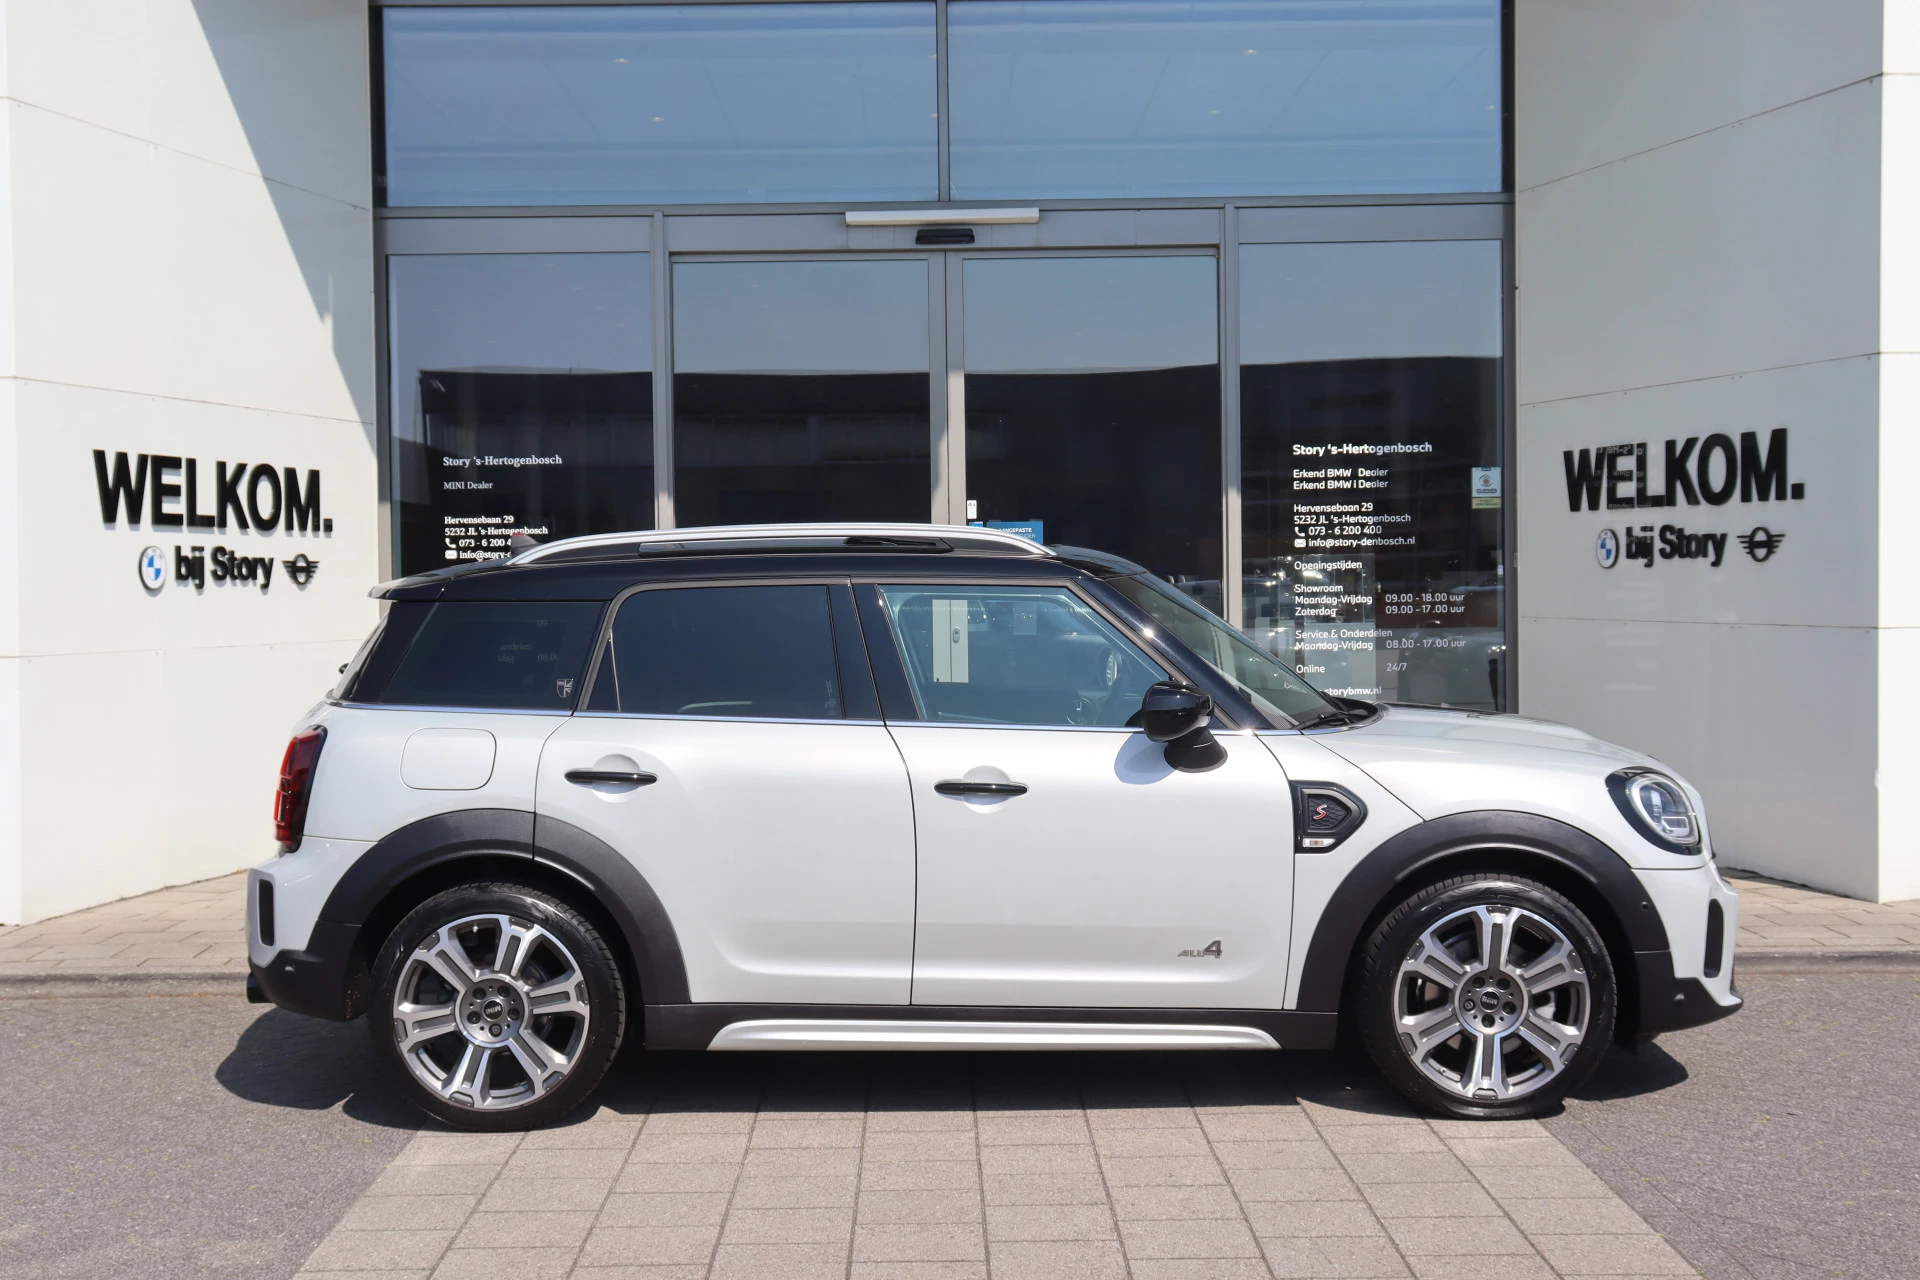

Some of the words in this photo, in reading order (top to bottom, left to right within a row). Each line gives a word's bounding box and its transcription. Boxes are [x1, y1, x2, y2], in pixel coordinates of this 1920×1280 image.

[1292, 444, 1325, 456] Story
[443, 456, 470, 468] Story
[1293, 469, 1325, 478] Erkend
[1327, 468, 1352, 477] BMW
[1358, 468, 1388, 476] Dealer
[1563, 428, 1804, 512] WELKOM.
[443, 481, 465, 490] MINI
[467, 481, 493, 489] Dealer
[1293, 481, 1325, 489] Erkend
[1327, 480, 1352, 489] BMW
[1353, 480, 1357, 488] i
[1358, 480, 1388, 488] Dealer
[93, 449, 333, 532] WELKOM.
[1294, 503, 1360, 512] Hervensebaan
[1361, 503, 1373, 511] 29
[444, 515, 501, 524] Hervensebaan
[503, 515, 514, 524] 29
[1294, 515, 1316, 524] 5232
[1318, 515, 1328, 524] JL
[1331, 514, 1411, 524] 's-Hertogenbosch
[445, 527, 465, 536] 5232
[467, 527, 477, 535] JL
[1309, 527, 1326, 536] 073
[1334, 526, 1341, 535] 6
[1342, 526, 1362, 535] 200
[1363, 525, 1382, 534] 400
[459, 539, 475, 547] 073
[482, 538, 488, 546] 6
[489, 538, 505, 546] 200
[1309, 536, 1415, 548] info@story-denbosch.nl
[1626, 526, 1654, 568] bij
[1659, 524, 1728, 568] Story
[174, 545, 205, 589] bij
[210, 546, 274, 589] Story
[1294, 561, 1362, 571] Openingstijden
[1295, 584, 1343, 593] Showroom
[1295, 595, 1373, 605] Maandag-Vrijdag
[1385, 593, 1413, 603] 09.00
[1421, 593, 1448, 602] 18.00
[1295, 607, 1337, 617] Zaterdag
[1385, 605, 1414, 614] 09.00
[1295, 630, 1329, 639] Service
[1331, 630, 1338, 638] &
[1340, 629, 1393, 638] Onderdelen
[1296, 641, 1374, 651] Maandag-Vrijdag
[1386, 639, 1414, 649] 08.00
[1296, 664, 1326, 673] Online
[1386, 663, 1408, 672] 24/7
[1313, 803, 1328, 820] S
